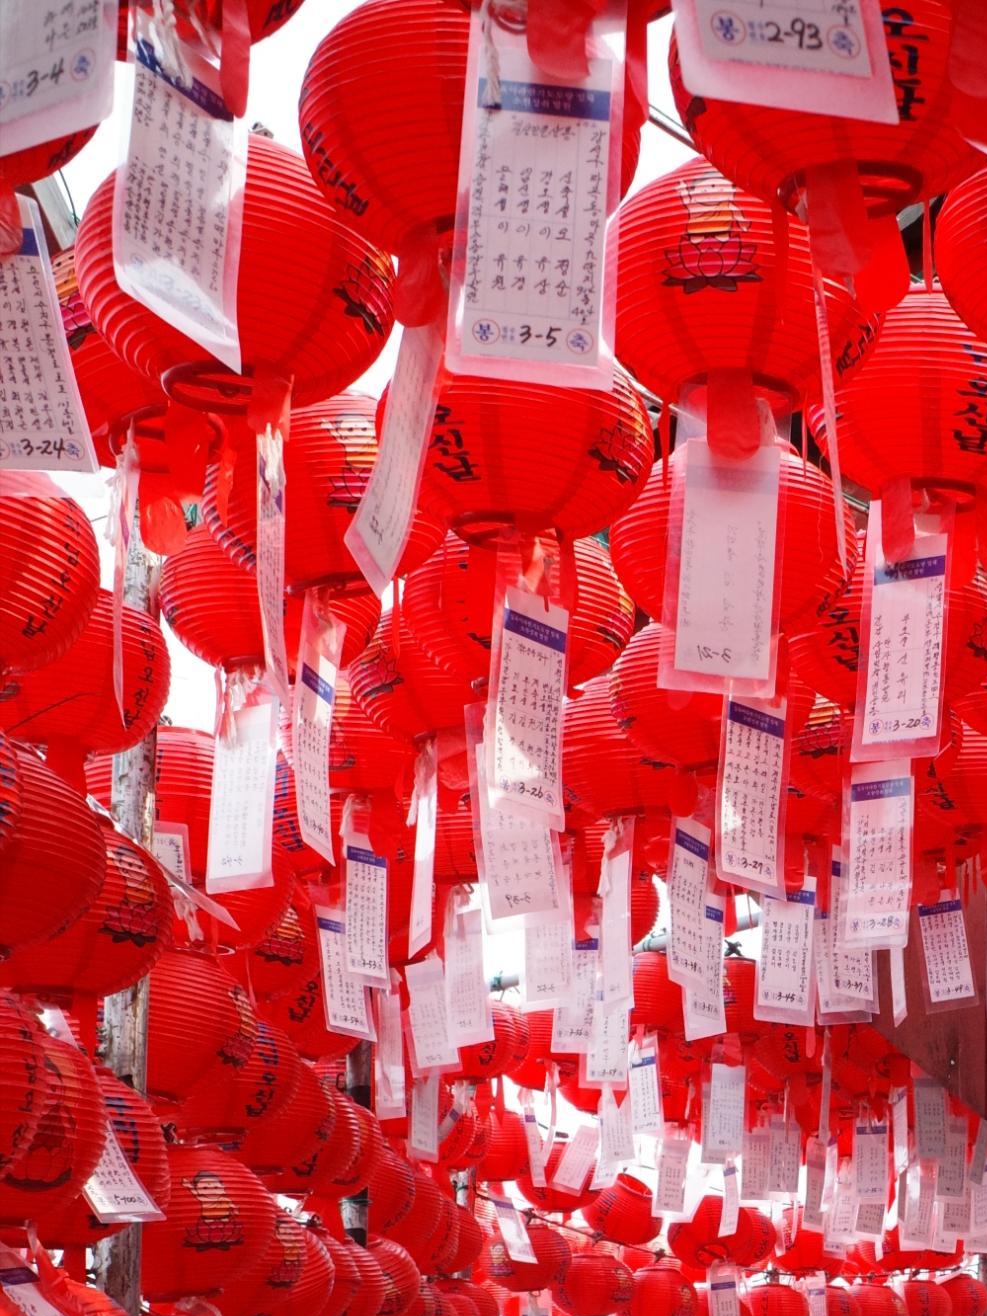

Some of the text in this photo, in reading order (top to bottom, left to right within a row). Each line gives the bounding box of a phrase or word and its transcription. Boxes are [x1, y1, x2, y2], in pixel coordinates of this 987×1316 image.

[766, 21, 823, 49] 2-93
[26, 56, 64, 97] 3-4
[475, 323, 494, 342] 봉
[519, 325, 562, 347] 3-5
[20, 437, 66, 460] 3-24
[869, 721, 881, 733] 봉
[892, 717, 922, 732] 3-20
[518, 780, 544, 799] 3-26
[740, 856, 764, 876] 3-27
[869, 915, 895, 930] 3-28
